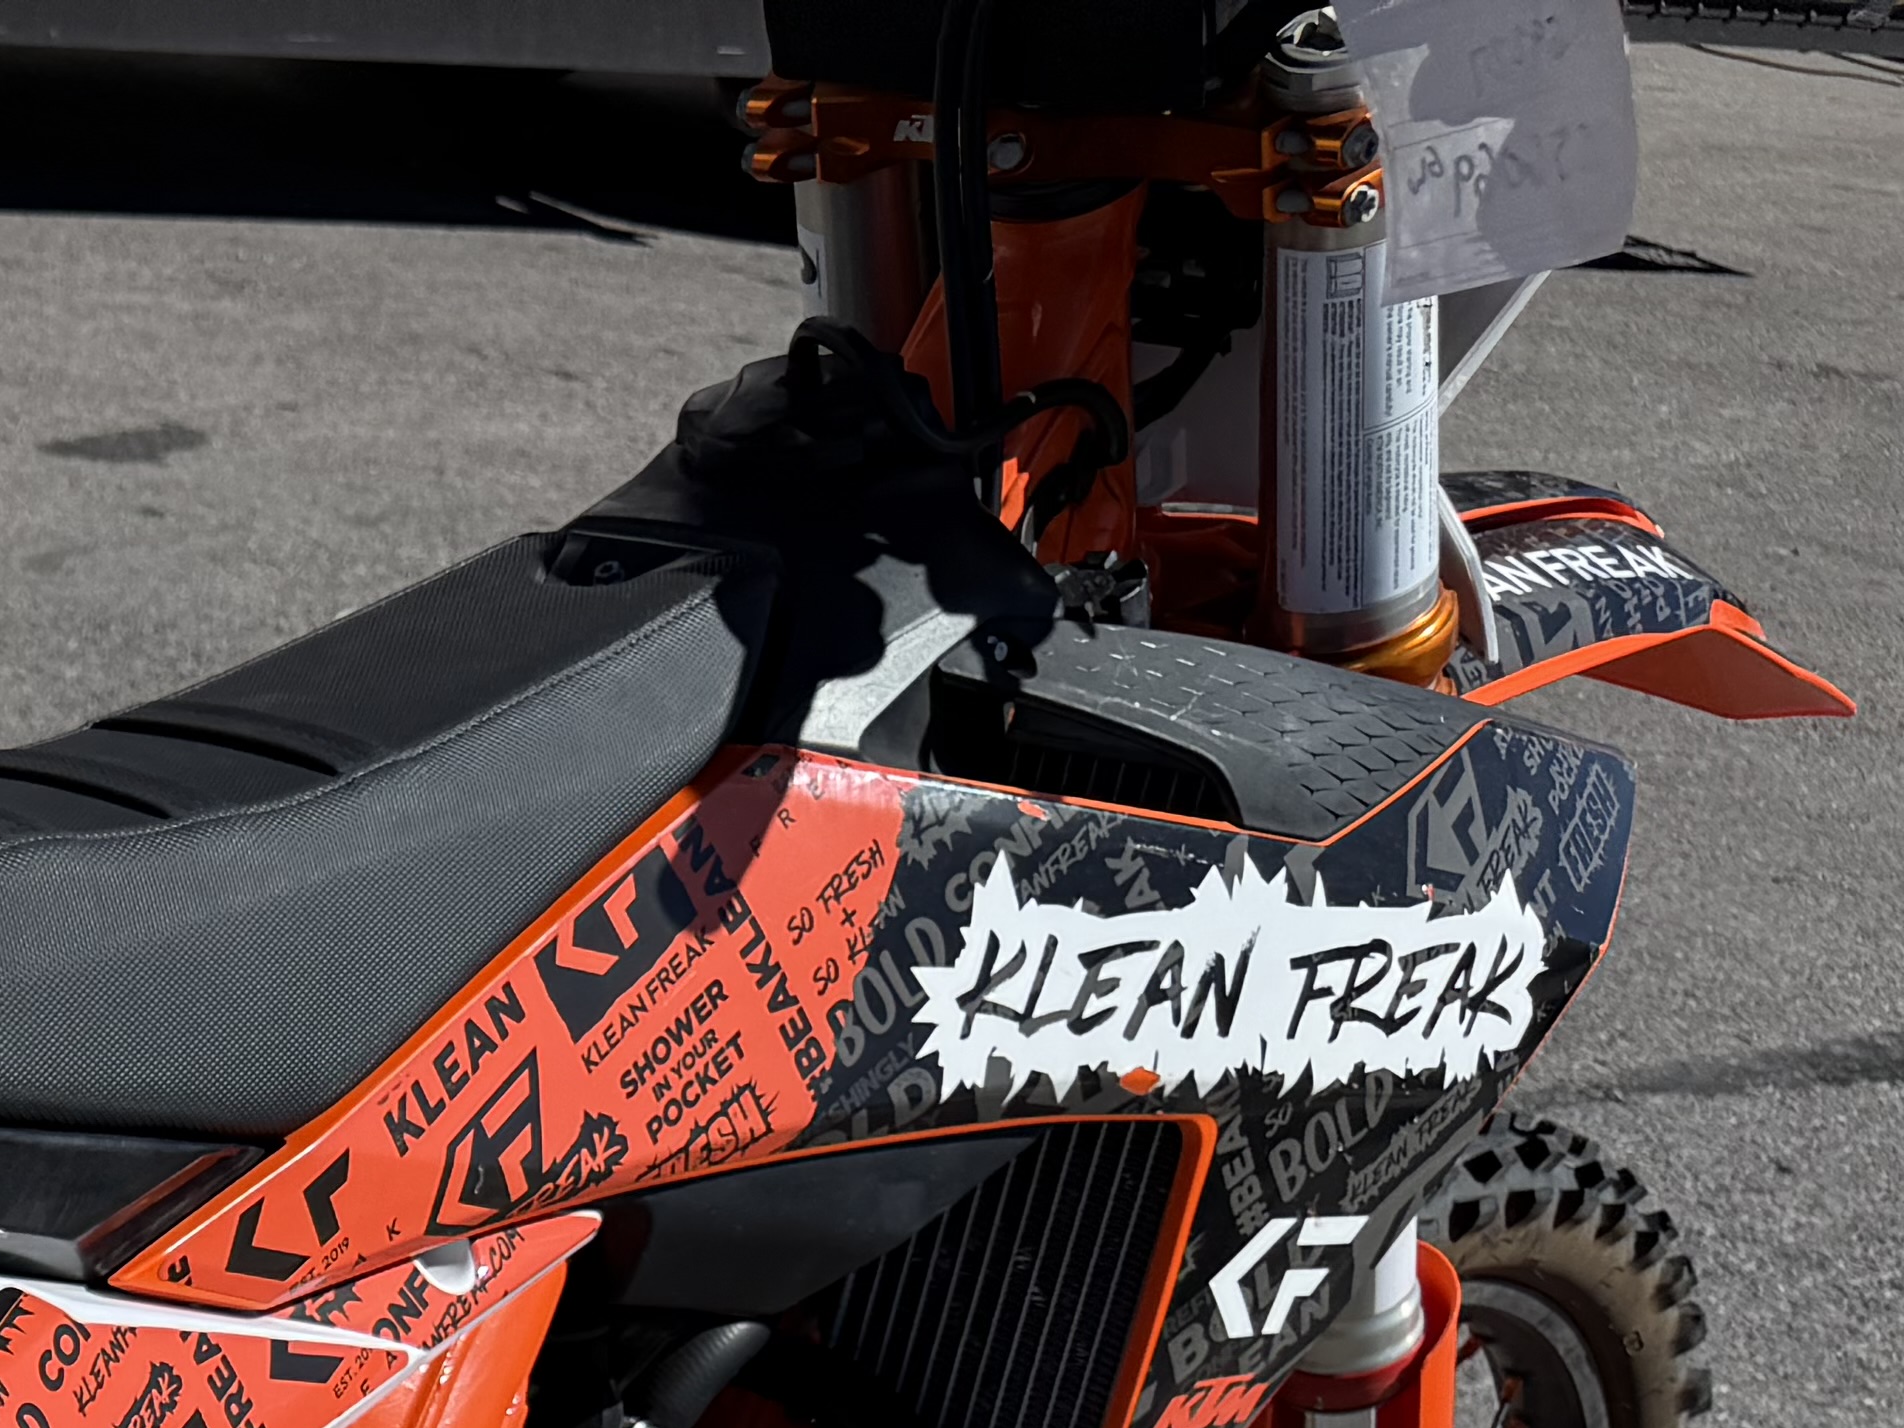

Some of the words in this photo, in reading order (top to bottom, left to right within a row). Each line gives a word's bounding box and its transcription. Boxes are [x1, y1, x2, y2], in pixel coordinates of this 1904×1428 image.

[1524, 544, 1694, 586] FREAK
[787, 905, 814, 946] SO
[816, 839, 885, 914] FRESH
[581, 992, 649, 1075] KLEAN
[645, 926, 715, 1005] FREAK
[813, 957, 840, 996] SO
[956, 925, 1259, 1041] KLEAN
[1288, 933, 1528, 1044] FREAK
[383, 981, 527, 1158] KLEAN
[620, 979, 730, 1099] SHOWER
[645, 1030, 745, 1146] POCKET
[652, 1074, 673, 1103] IN
[671, 1028, 721, 1081] YOUR
[1268, 1070, 1392, 1202] BOLD
[321, 1237, 350, 1270] 2019
